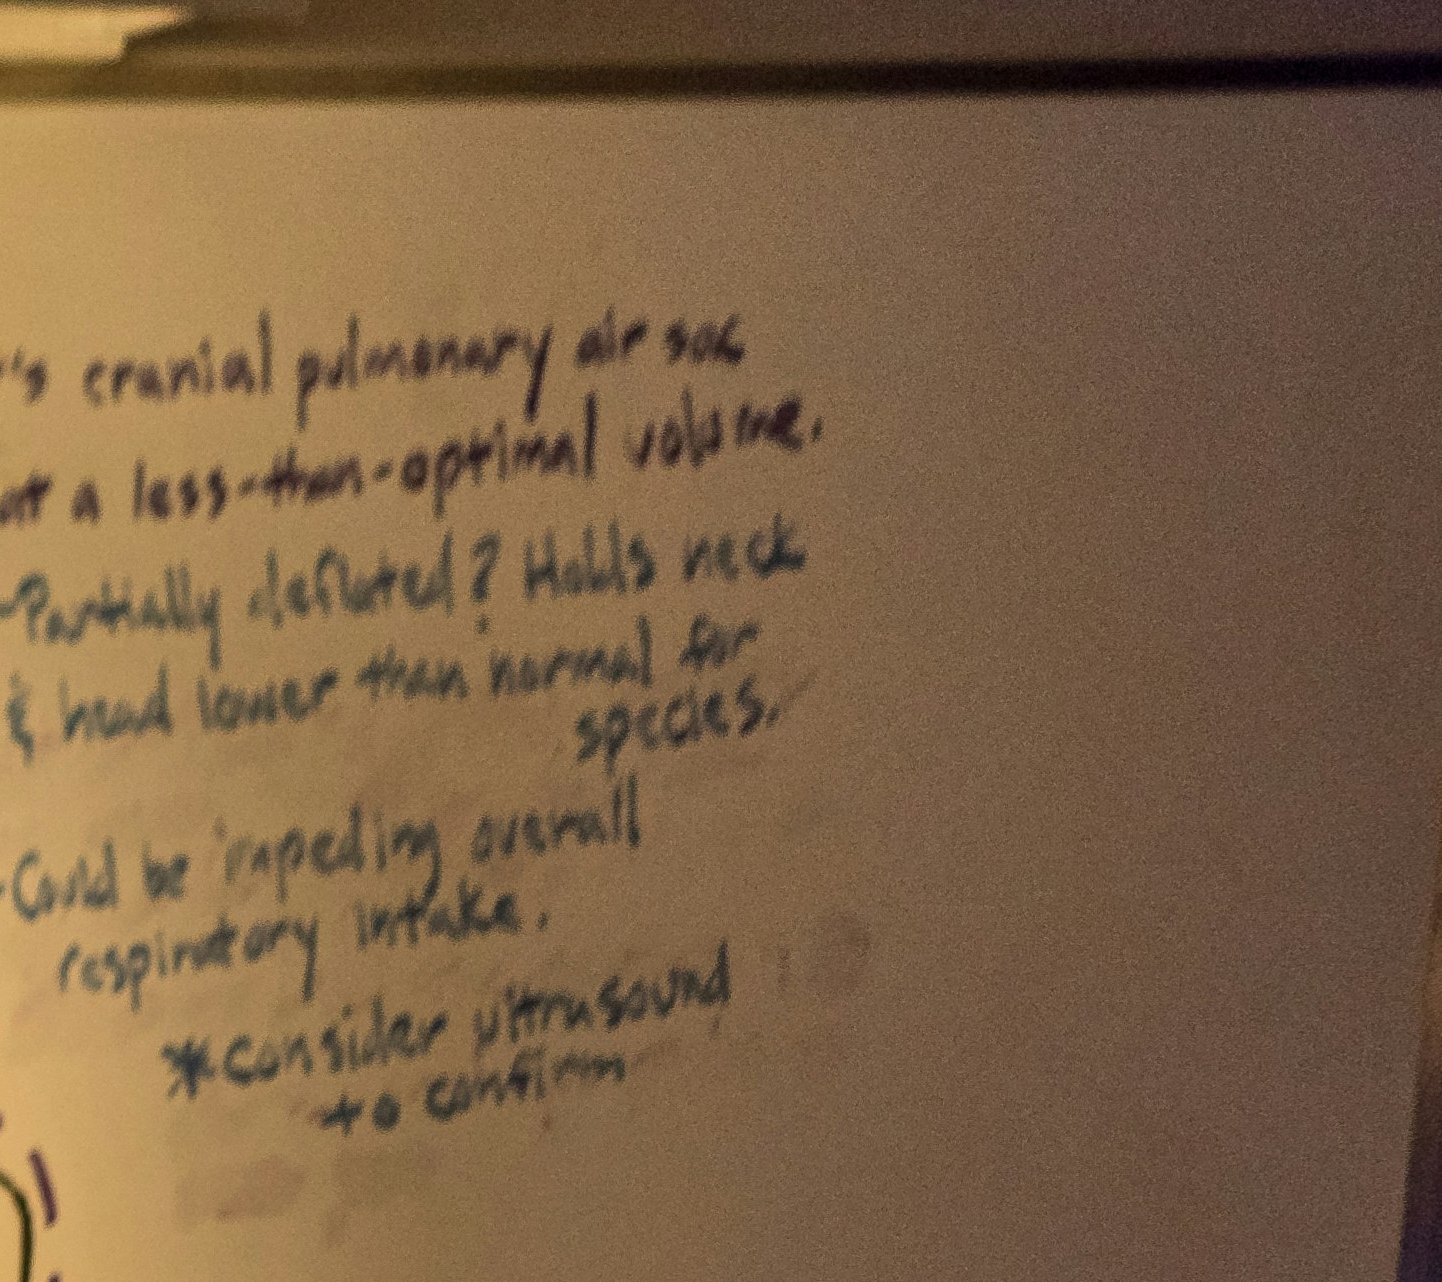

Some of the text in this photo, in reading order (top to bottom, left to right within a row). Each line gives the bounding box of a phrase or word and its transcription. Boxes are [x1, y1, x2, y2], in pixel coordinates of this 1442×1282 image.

[82, 306, 273, 407] cranial
[296, 311, 556, 433] pulmonary
[574, 304, 649, 367] air
[628, 384, 826, 470] volume.
[681, 510, 808, 583] neck
[197, 668, 340, 735] lower
[357, 642, 470, 702] than
[488, 612, 657, 697] normal
[677, 608, 760, 672] for
[141, 840, 191, 904] be
[214, 800, 442, 905] impeding
[471, 772, 642, 868] overall
[56, 880, 549, 1013] respiratory intake.
[474, 936, 732, 1050] ultrasound
[321, 1088, 402, 1136] to
